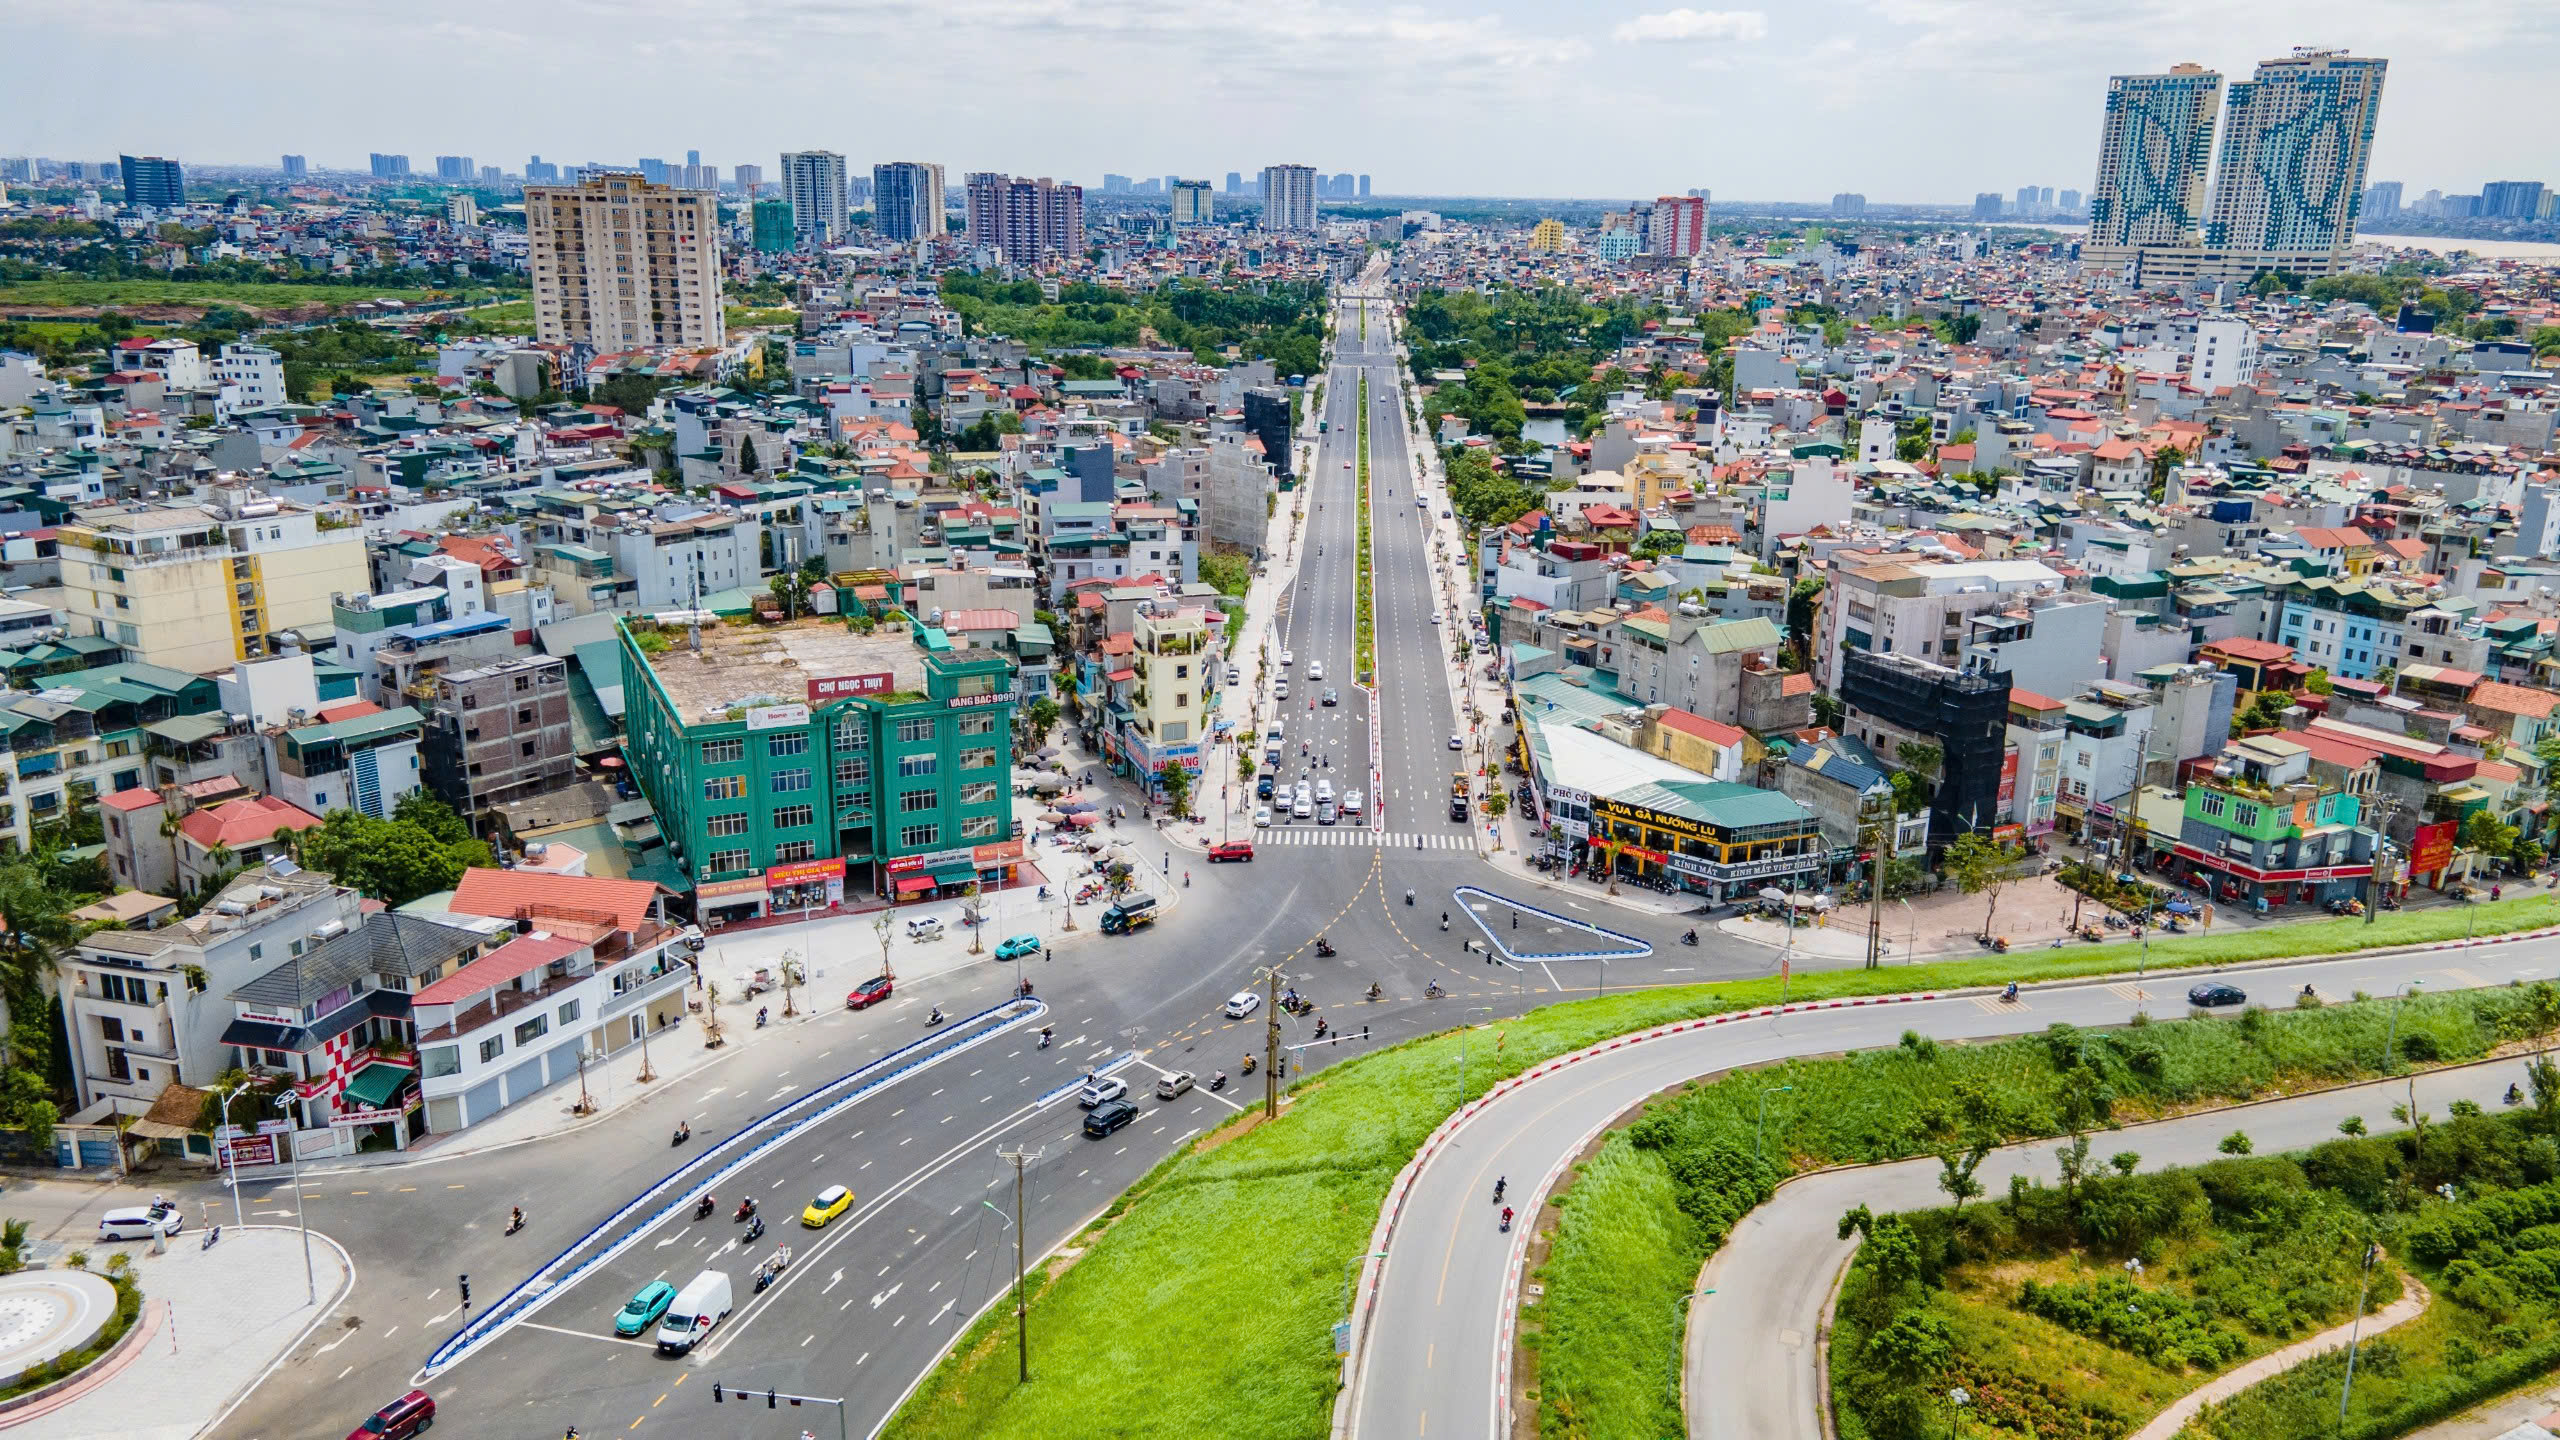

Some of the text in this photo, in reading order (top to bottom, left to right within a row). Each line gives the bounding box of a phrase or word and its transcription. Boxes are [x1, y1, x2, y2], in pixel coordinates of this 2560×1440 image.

[818, 681, 836, 694] CHỢ
[838, 680, 861, 693] NGỌC
[992, 692, 1015, 703] 9999
[1608, 802, 1632, 816] VUA
[1635, 808, 1653, 821] GÀ
[1655, 814, 1698, 832] NƯỚNG
[1700, 825, 1716, 836] LU
